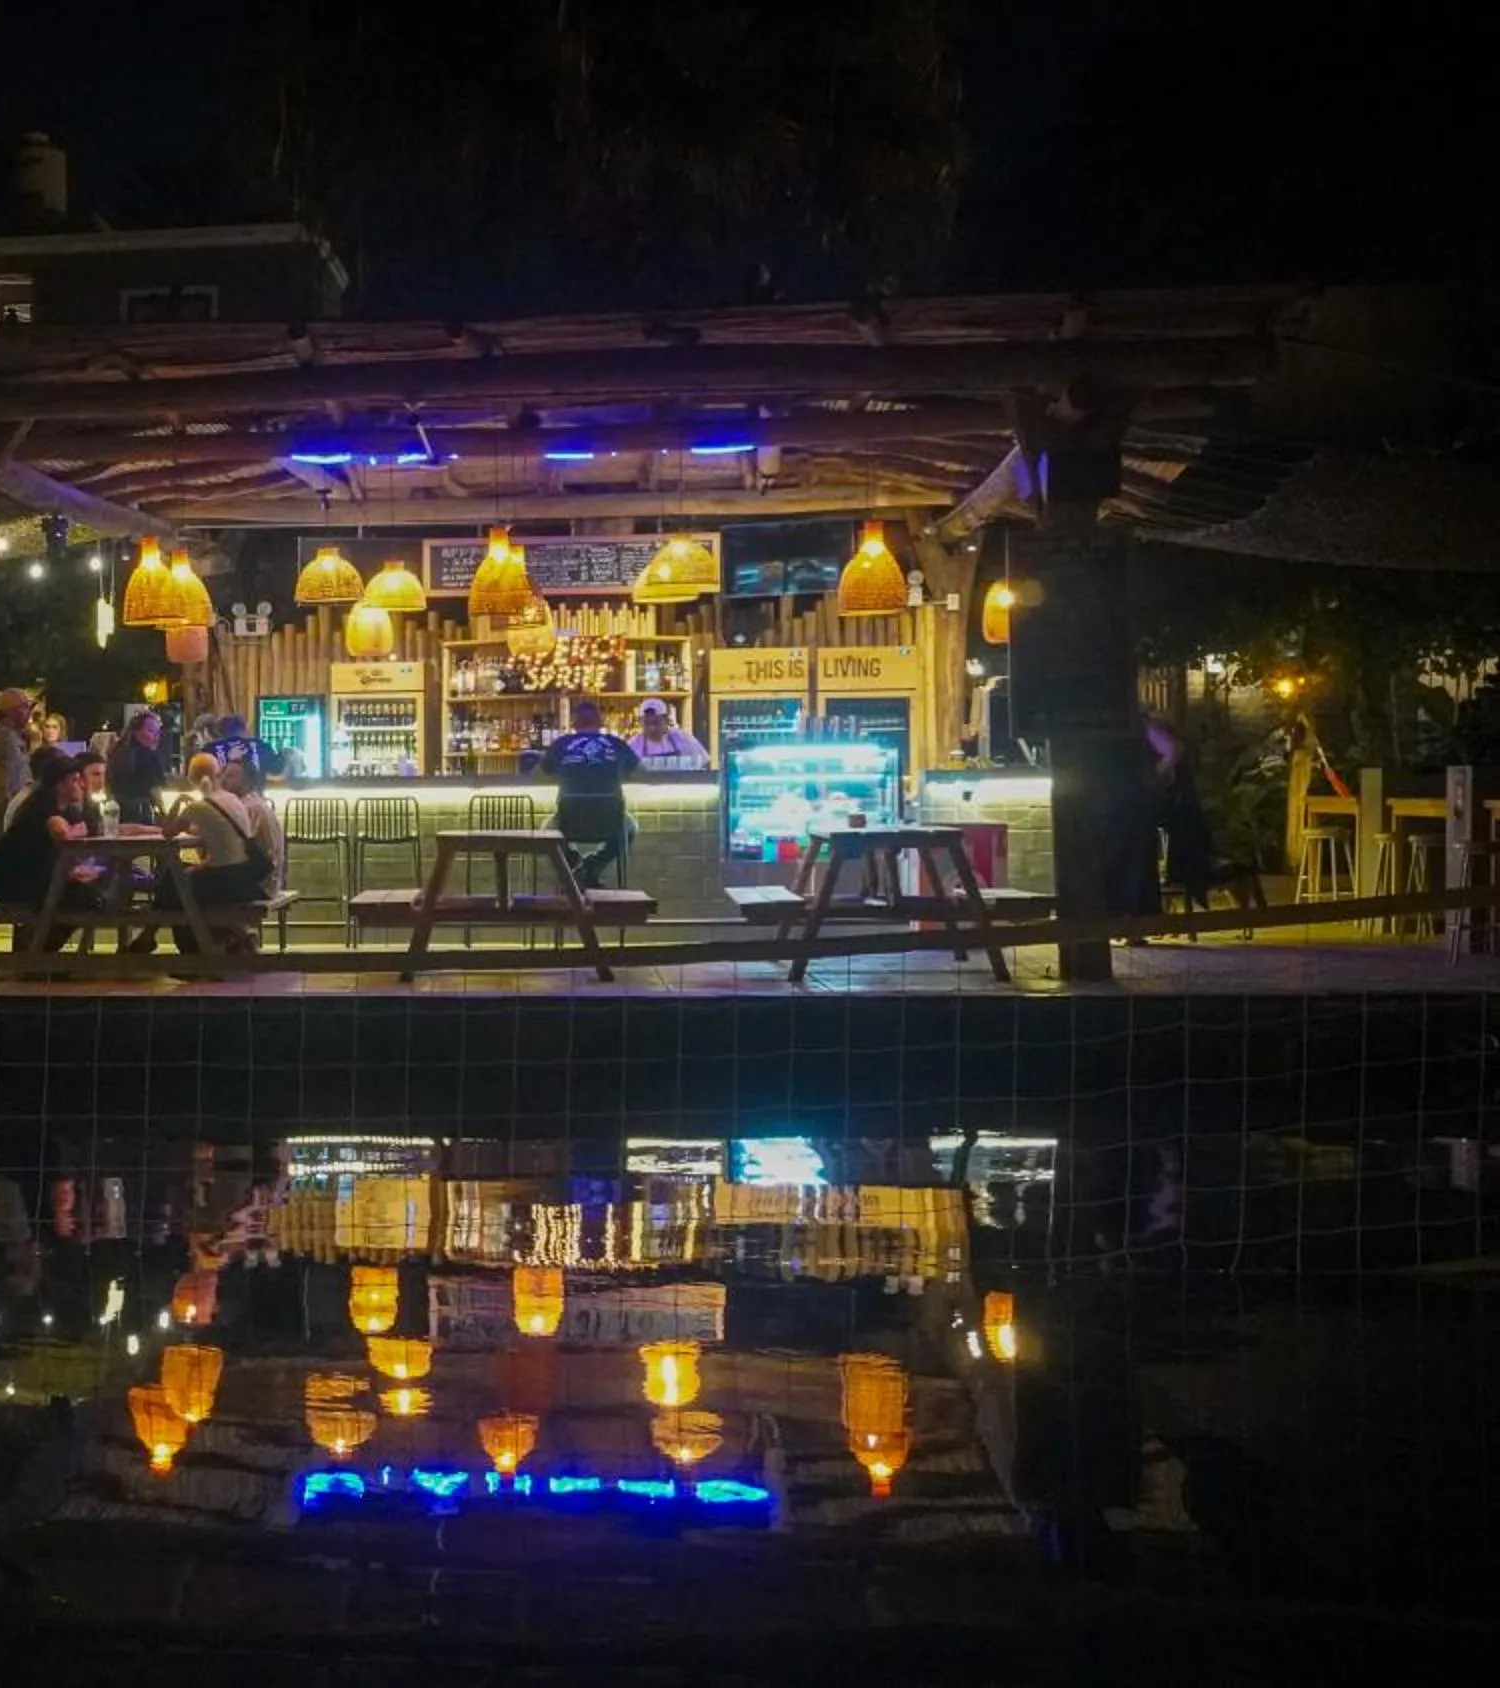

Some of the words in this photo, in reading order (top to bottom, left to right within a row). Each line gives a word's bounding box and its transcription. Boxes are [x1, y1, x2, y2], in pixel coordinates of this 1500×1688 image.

[744, 659, 784, 684] THIS
[788, 659, 805, 678] IS
[823, 655, 882, 678] LIVING
